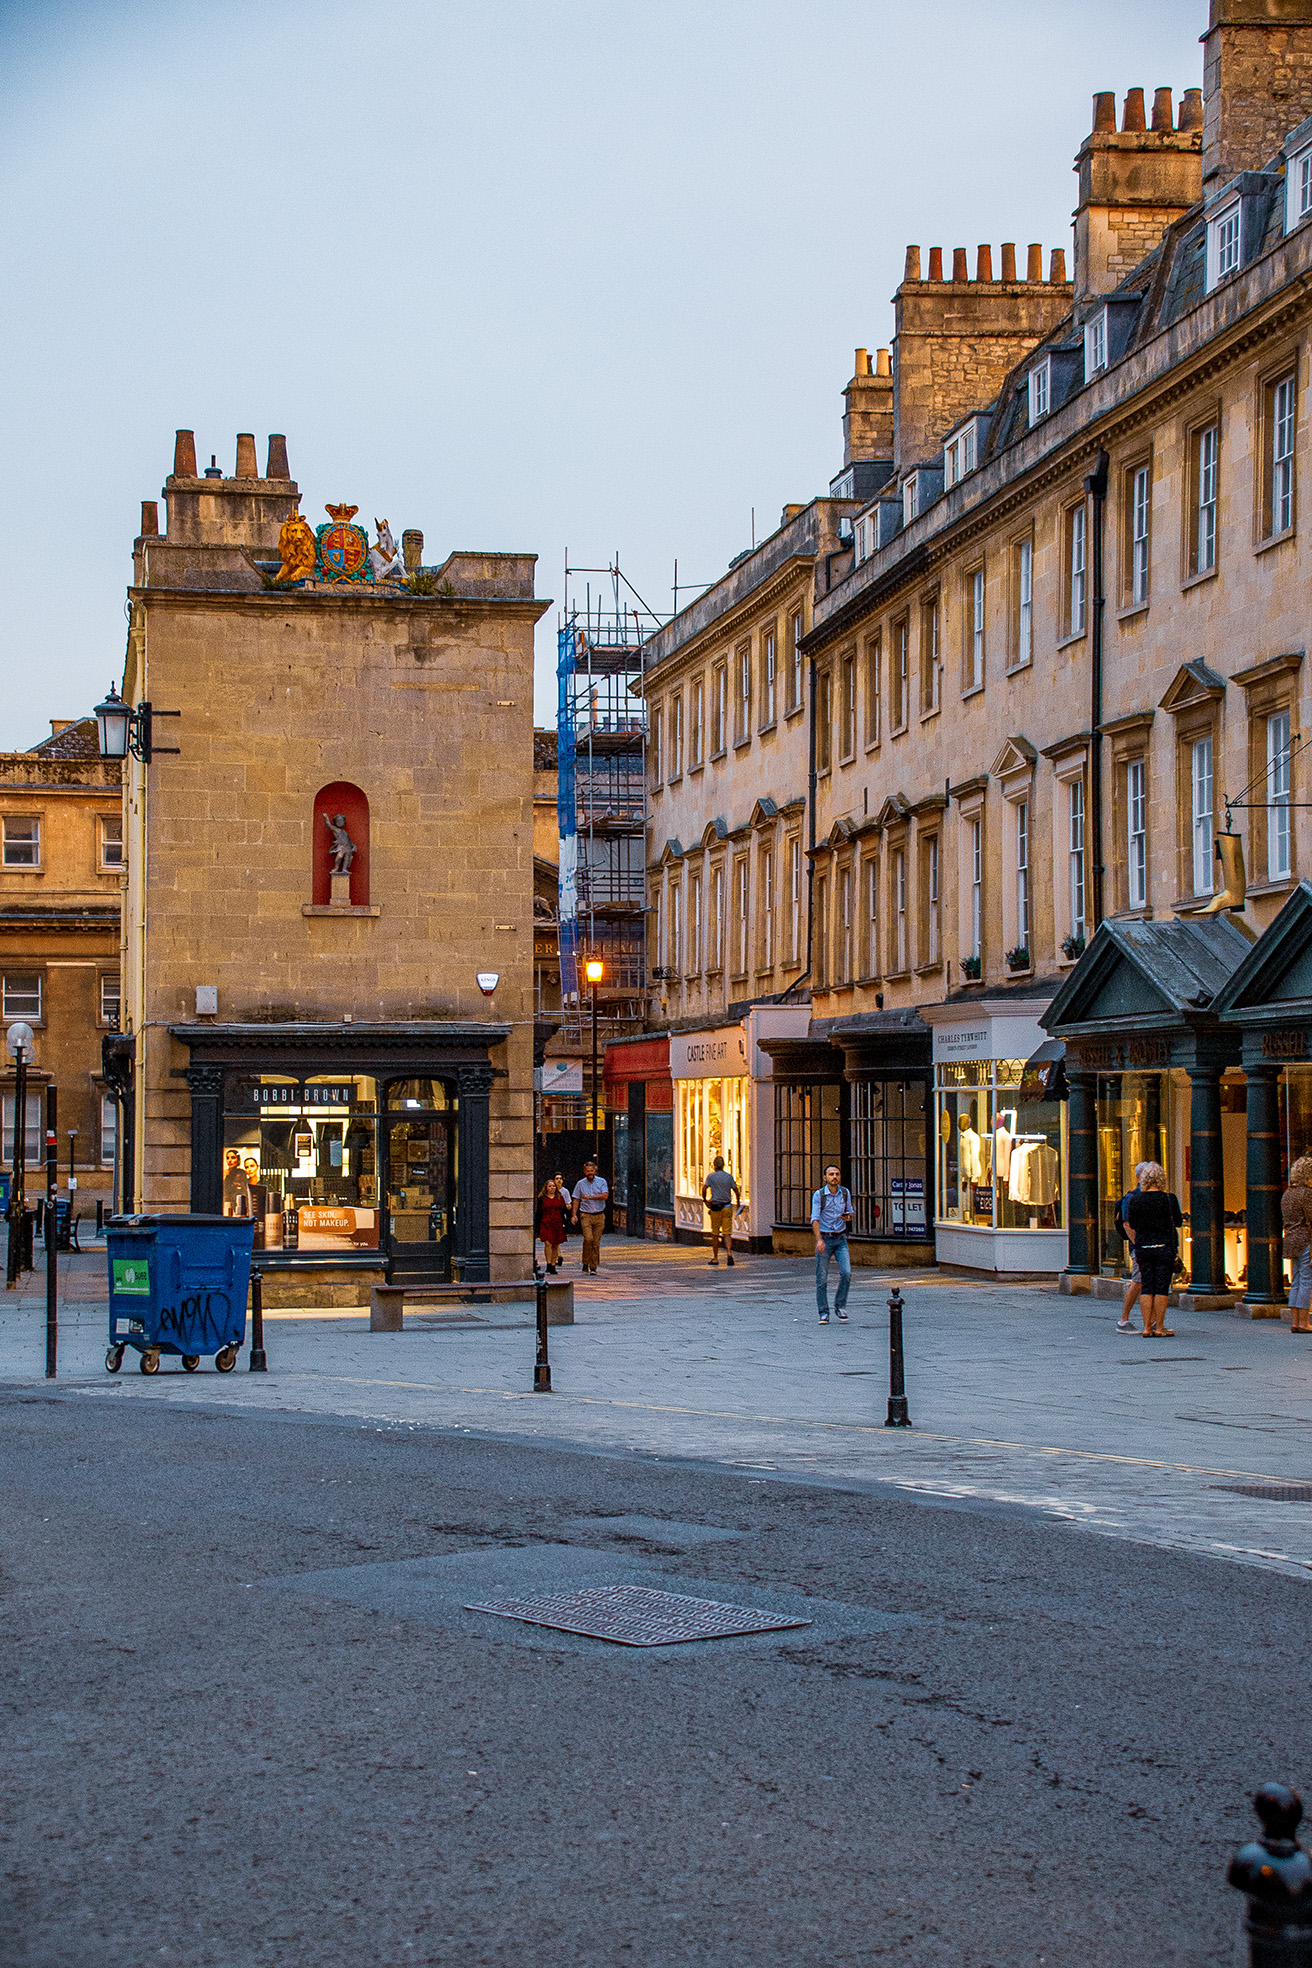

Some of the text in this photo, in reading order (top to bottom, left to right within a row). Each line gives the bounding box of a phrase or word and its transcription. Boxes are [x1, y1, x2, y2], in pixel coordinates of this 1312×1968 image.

[938, 1033, 960, 1044] CHARLES
[687, 1042, 727, 1062] CASTLE FINE ART
[253, 1088, 349, 1102] BOBBI BROWN
[908, 1203, 923, 1211] LET
[303, 1211, 316, 1219] SEE
[303, 1219, 317, 1227] NOT
